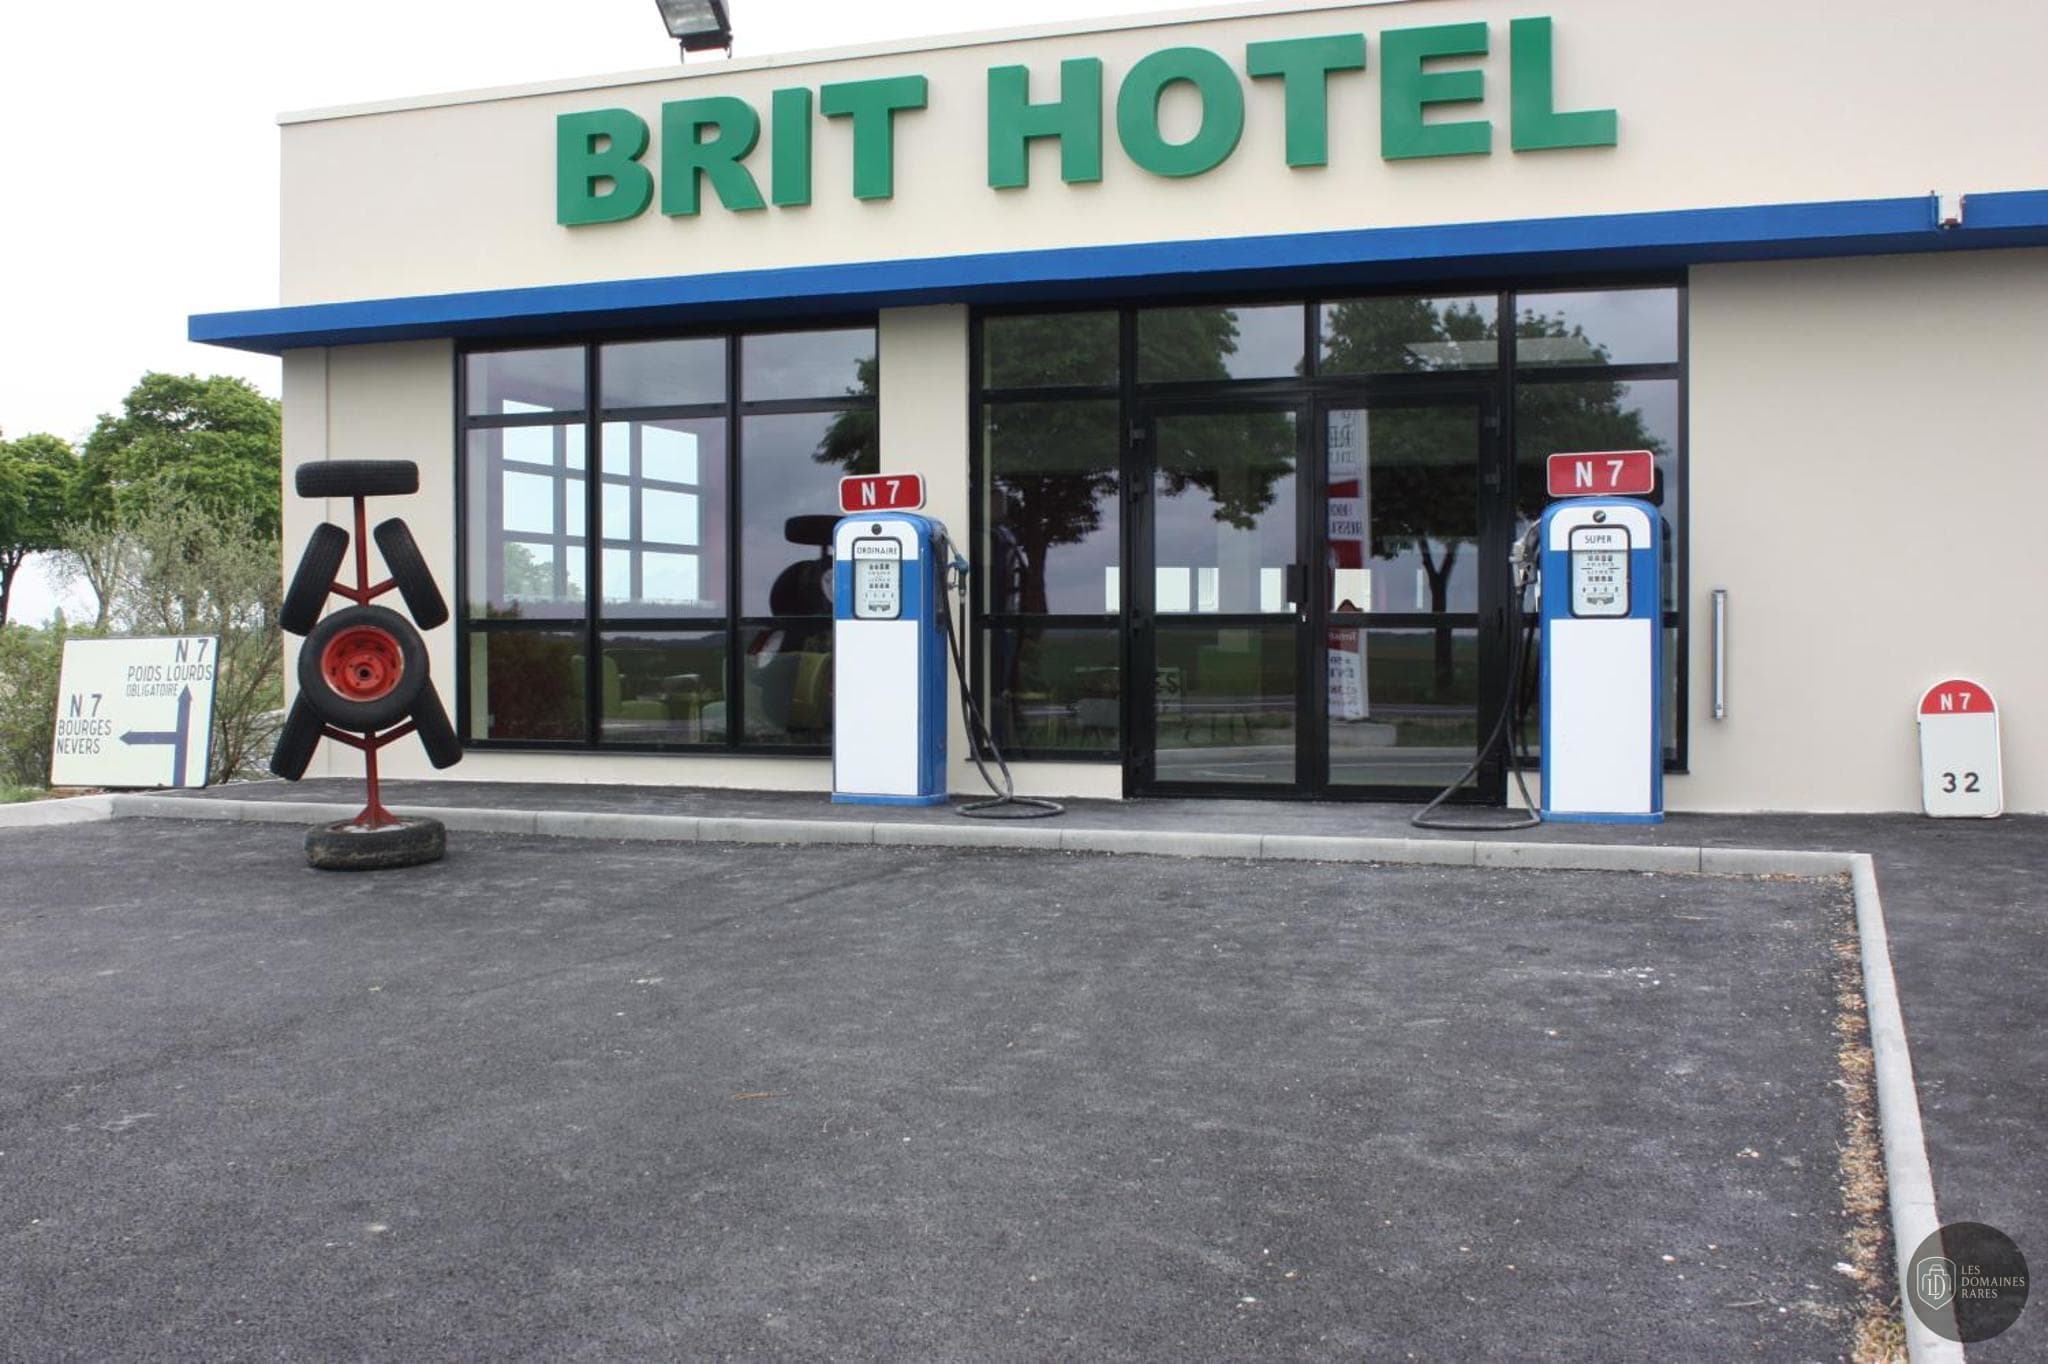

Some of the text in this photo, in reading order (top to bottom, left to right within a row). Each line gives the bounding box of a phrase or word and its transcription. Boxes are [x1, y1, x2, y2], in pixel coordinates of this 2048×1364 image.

[555, 16, 1617, 228] BRIT HOTEL
[1584, 535, 1612, 544] SUPER
[856, 546, 898, 555] ORDINAIRE
[127, 664, 212, 682] POIDS LOURDS
[126, 683, 178, 697] OBLIGATOIRE
[58, 719, 112, 736] BOURGES
[56, 737, 101, 754] NEVERS
